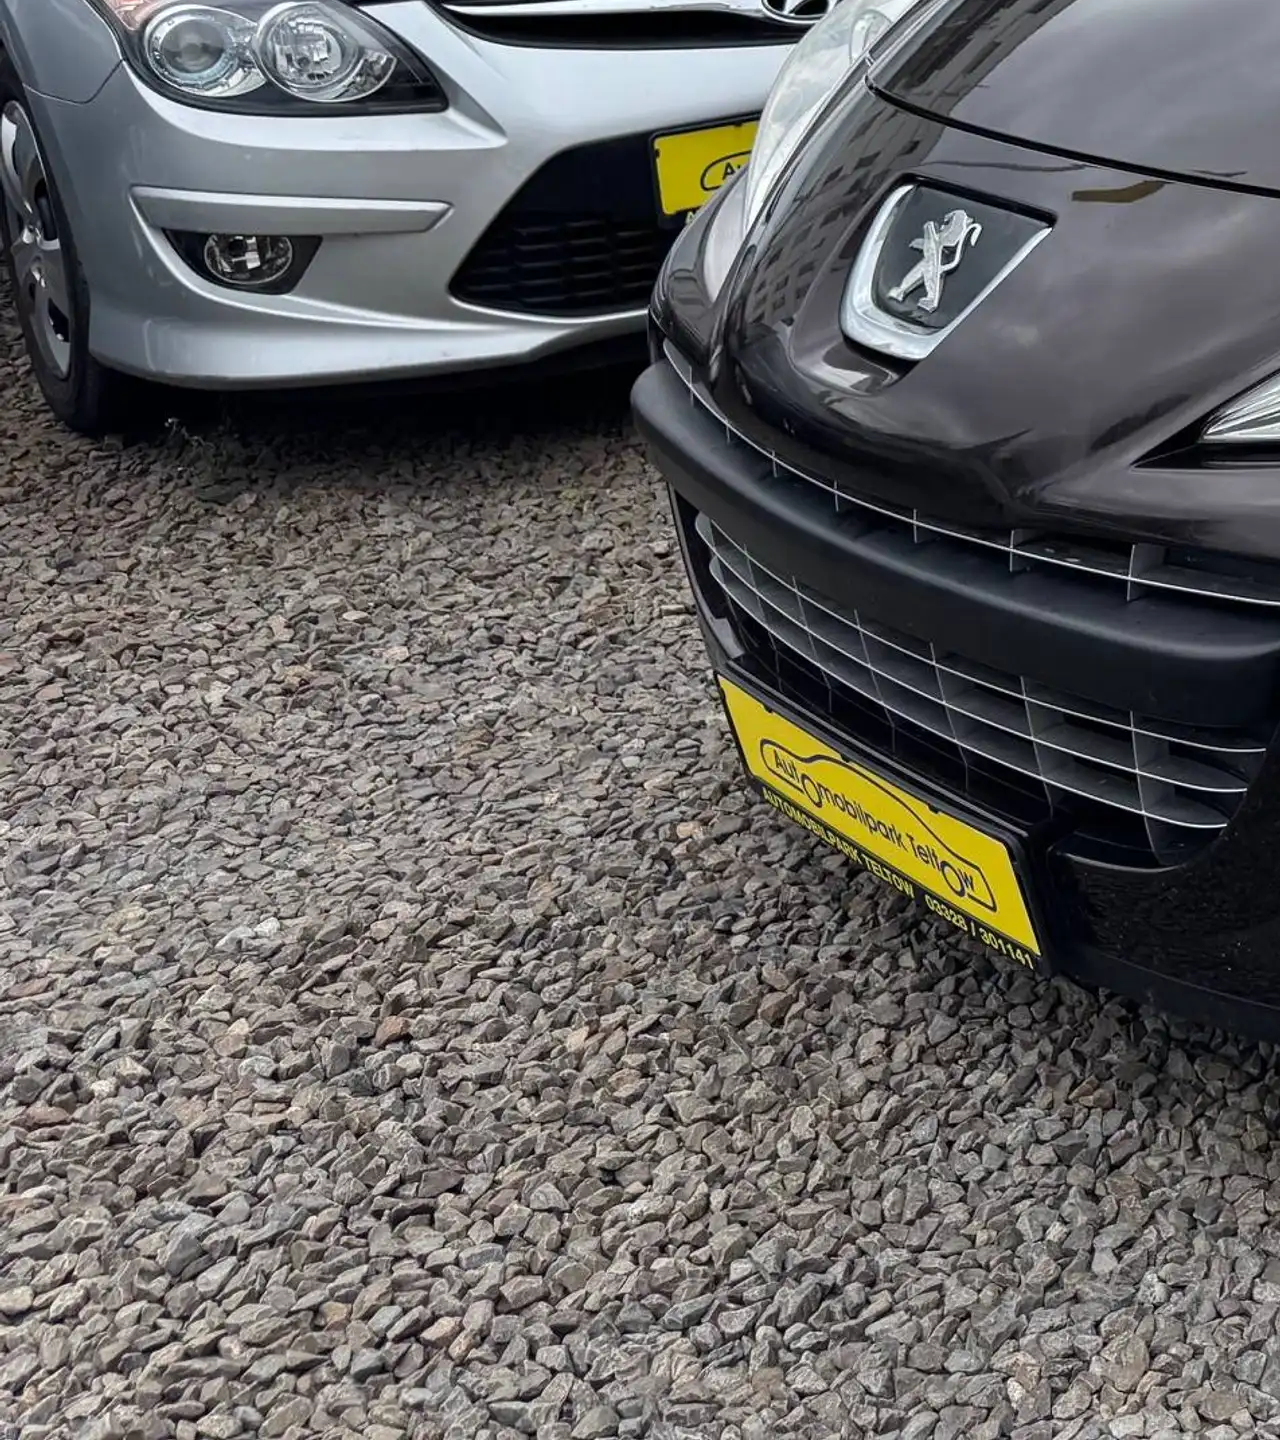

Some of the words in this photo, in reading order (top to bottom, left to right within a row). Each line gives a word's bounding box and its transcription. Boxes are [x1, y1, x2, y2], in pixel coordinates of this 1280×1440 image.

[762, 786, 862, 865] AUTOMOBILPARK
[861, 853, 915, 899] TELTOW
[924, 894, 968, 932] 03328
[979, 927, 1034, 970] 301141
